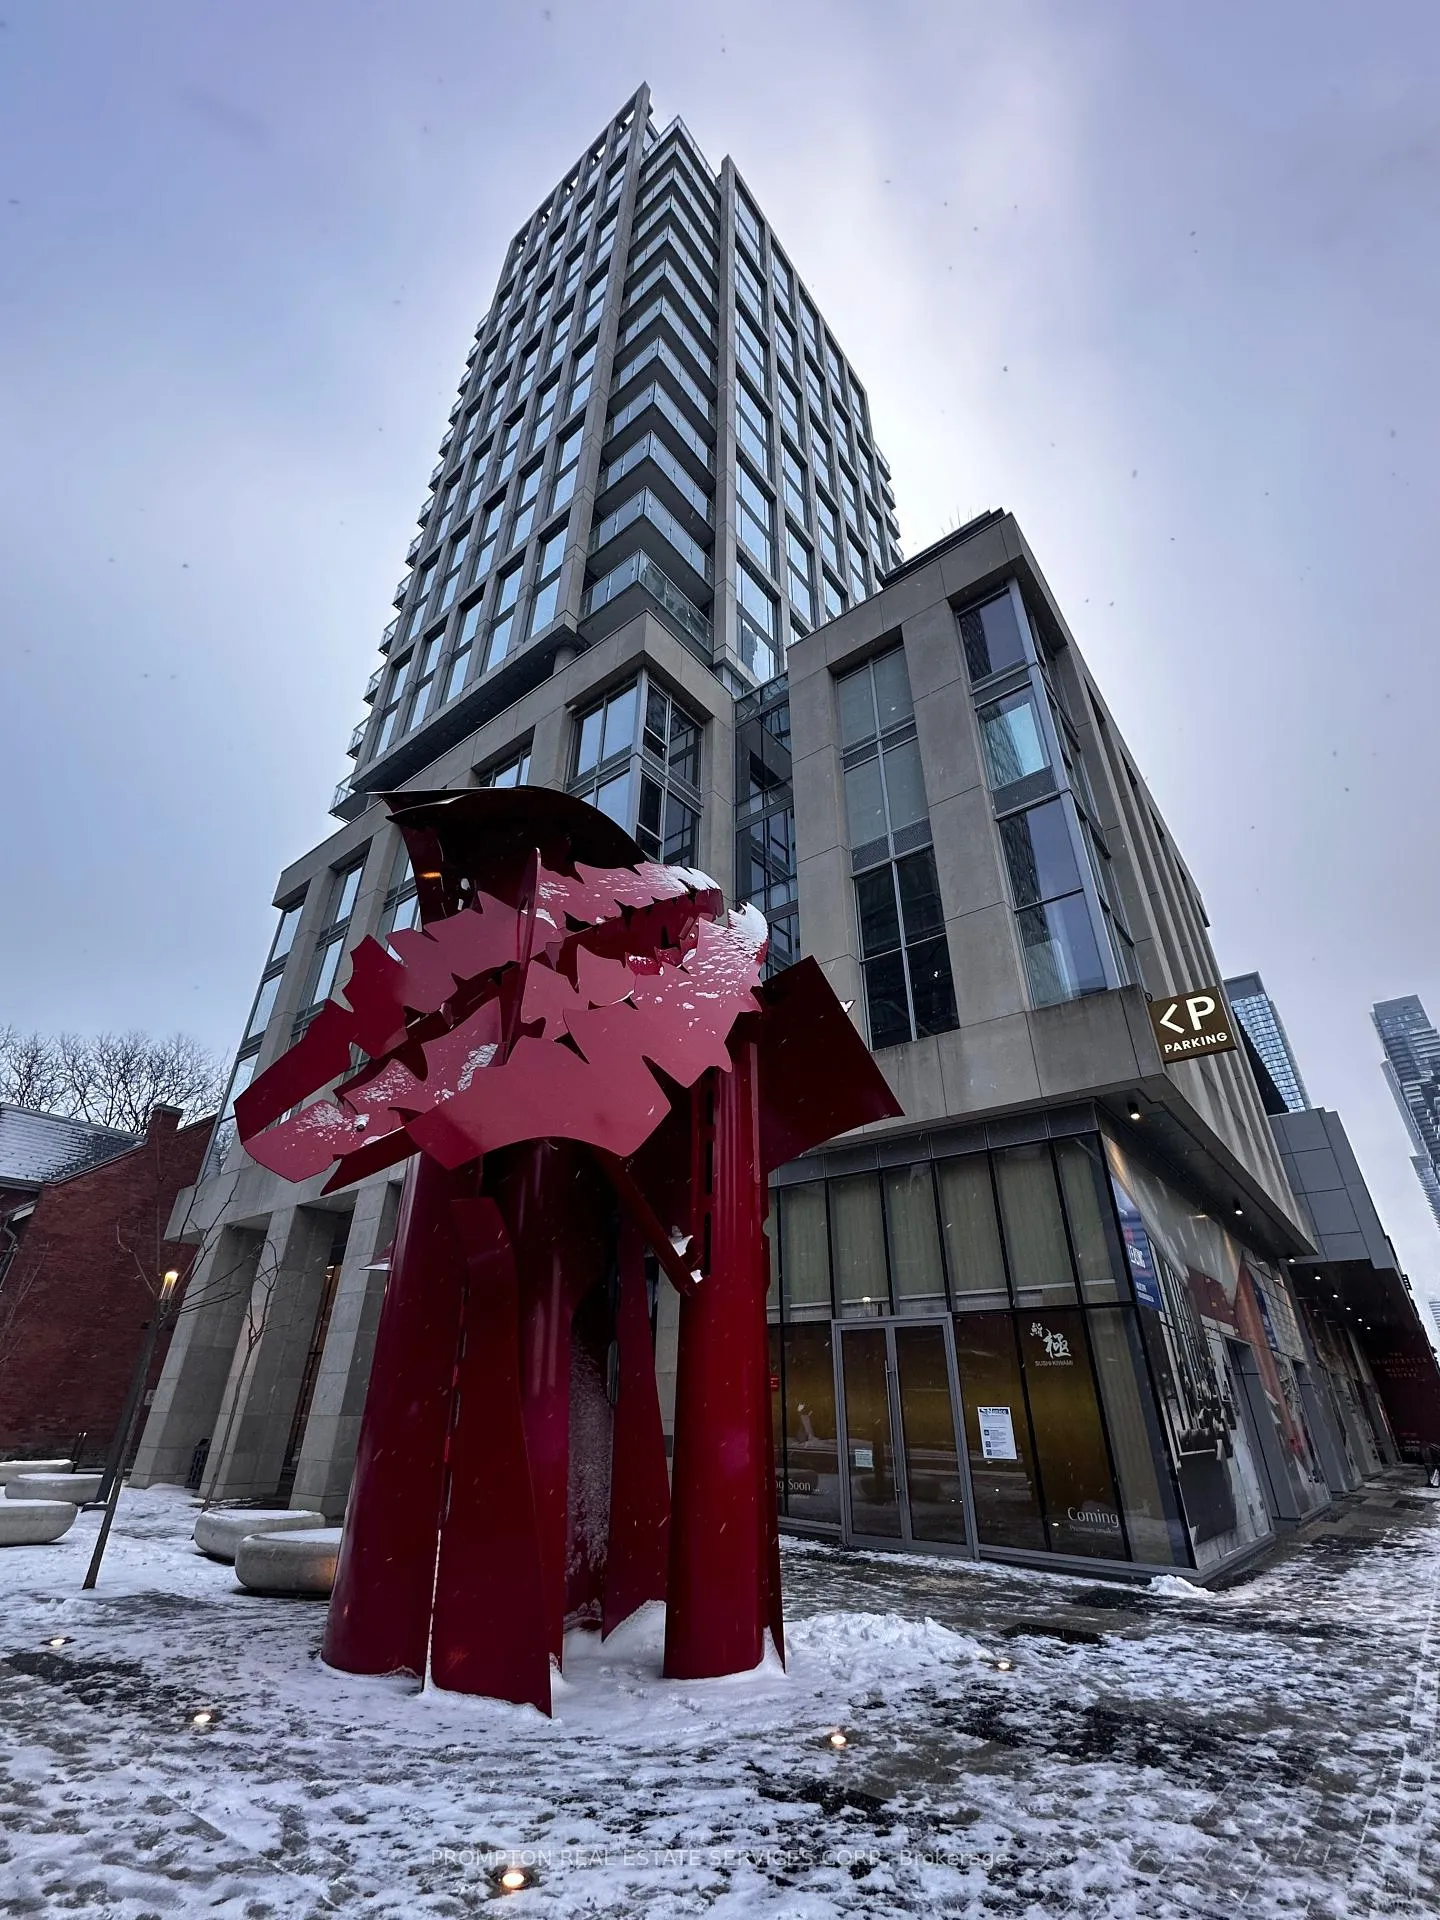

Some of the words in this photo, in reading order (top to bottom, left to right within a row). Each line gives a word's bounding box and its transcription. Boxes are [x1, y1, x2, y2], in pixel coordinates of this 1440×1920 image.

[1185, 996, 1216, 1031] P
[1164, 1032, 1228, 1054] PARKING
[788, 1478, 811, 1491] Soon
[1067, 1506, 1119, 1528] Coming
